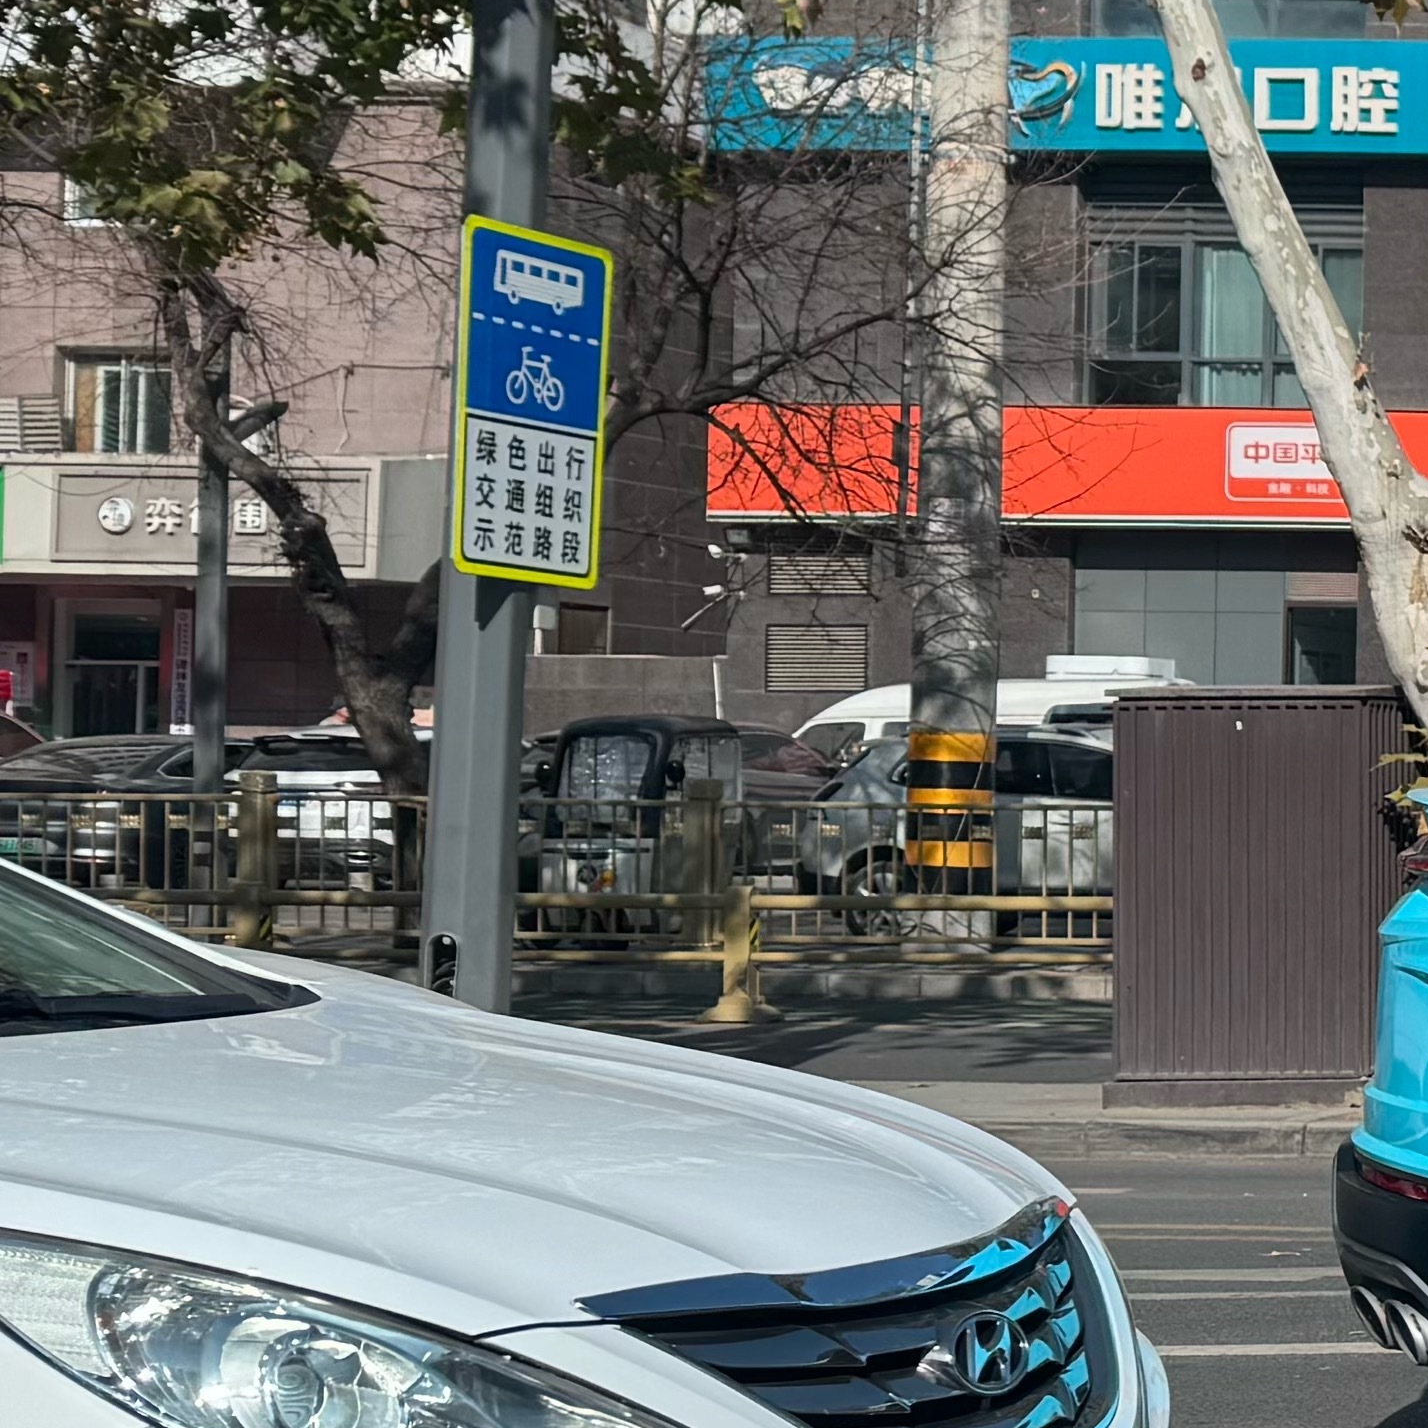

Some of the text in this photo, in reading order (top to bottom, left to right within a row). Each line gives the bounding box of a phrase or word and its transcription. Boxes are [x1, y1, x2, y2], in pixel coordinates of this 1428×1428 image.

[1096, 63, 1398, 133] 唯口腔
[475, 428, 585, 481] 绿色出行
[475, 473, 582, 523] 交通组织
[473, 517, 580, 564] 示范路段
